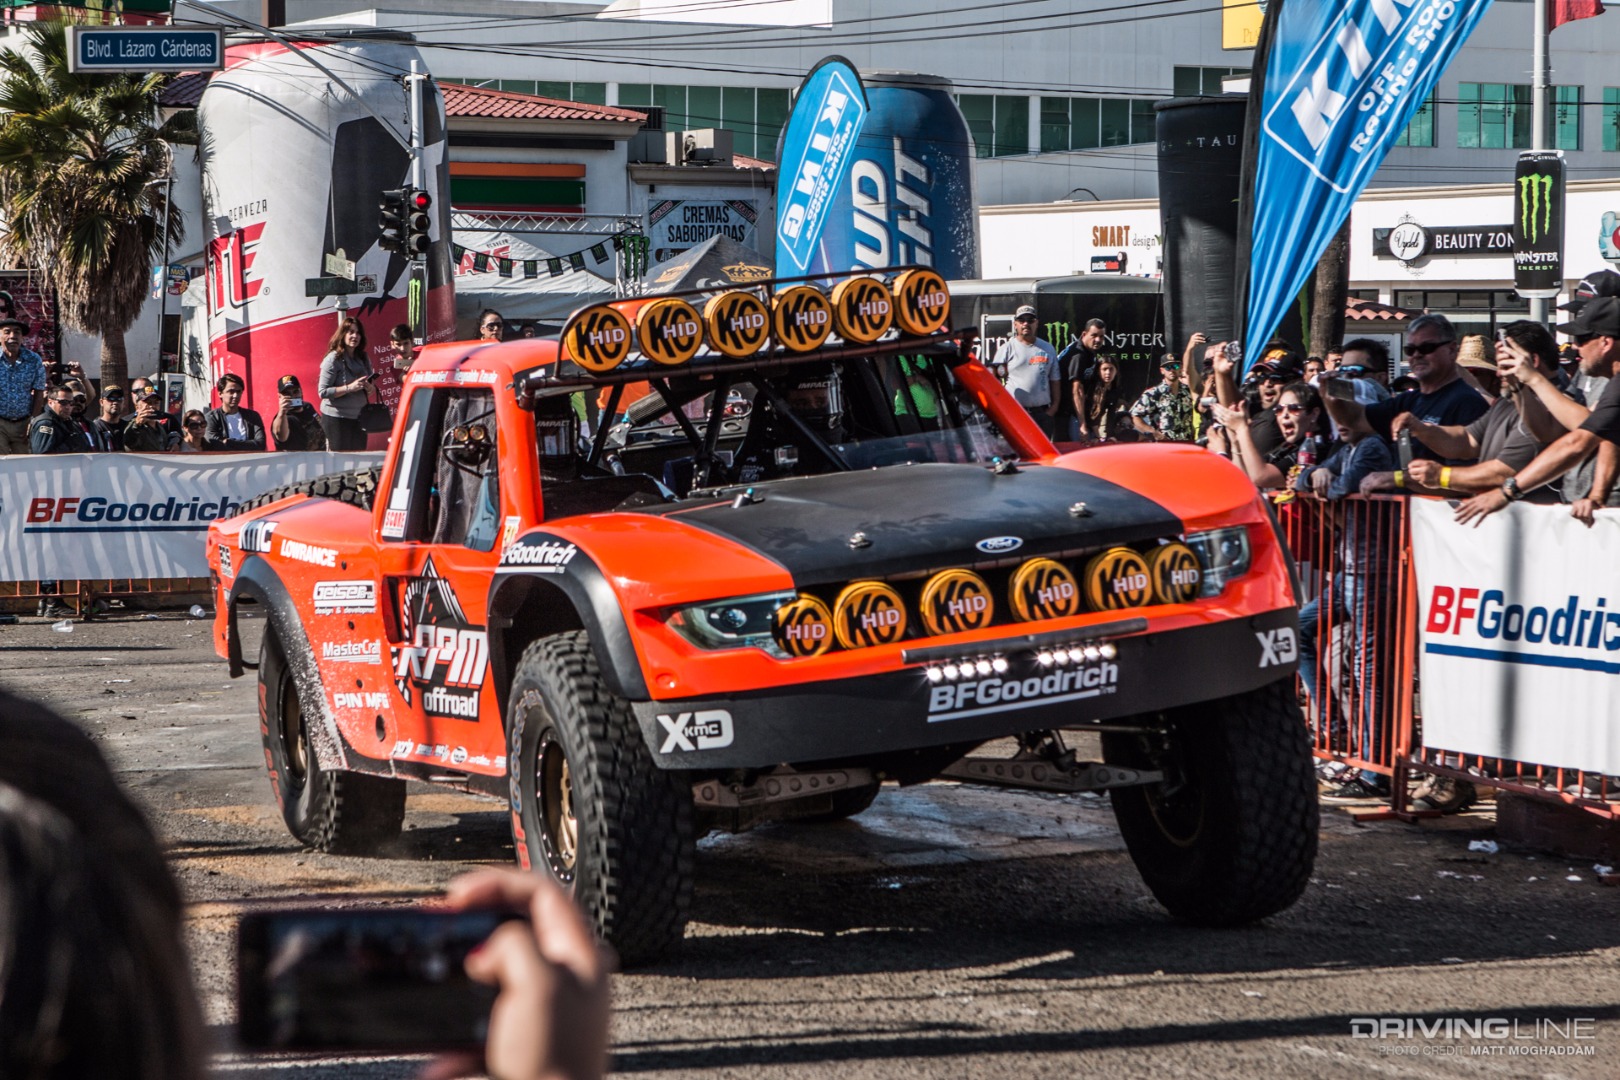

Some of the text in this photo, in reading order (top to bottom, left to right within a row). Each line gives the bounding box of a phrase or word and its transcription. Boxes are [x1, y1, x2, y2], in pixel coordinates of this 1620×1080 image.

[87, 39, 212, 58] Blvd. Lázaro Cárdenas
[1419, 0, 1458, 54] SHO
[1358, 62, 1397, 112] OFF
[228, 199, 268, 222] CERVEZA
[683, 205, 730, 224] CREMAS
[1092, 225, 1156, 250] SMART design
[1435, 232, 1515, 249] BEAUTY ZON
[784, 294, 829, 345] KC HID
[848, 285, 890, 334] KC HID
[907, 278, 947, 324] KC HID
[577, 314, 626, 364] KC HID
[650, 308, 698, 358] KC HID
[718, 300, 765, 350] KC HID
[1071, 330, 1166, 349] NSTER
[373, 345, 392, 355] Nac
[1096, 352, 1151, 361] NRGY
[798, 381, 833, 390] IMPACT
[536, 420, 571, 428] IMPACT
[389, 420, 421, 510] 1
[26, 496, 239, 524] BFGoodrich
[386, 511, 406, 528] SCORE
[280, 539, 339, 567] LOWRANCE
[500, 540, 577, 565] Goodrich
[985, 537, 1015, 550] Ford
[1024, 569, 1073, 619] KC HID
[1100, 559, 1149, 609] KC HID
[1160, 551, 1199, 599] KC HID
[850, 594, 900, 644] KC HID
[934, 580, 987, 634] KC HID
[1425, 585, 1620, 652] BFGoodric
[775, 606, 826, 655] KC HID
[1255, 626, 1298, 669] XD
[424, 687, 479, 718] offroad
[928, 661, 1119, 714] BFGoodrich
[656, 709, 735, 754] XD
